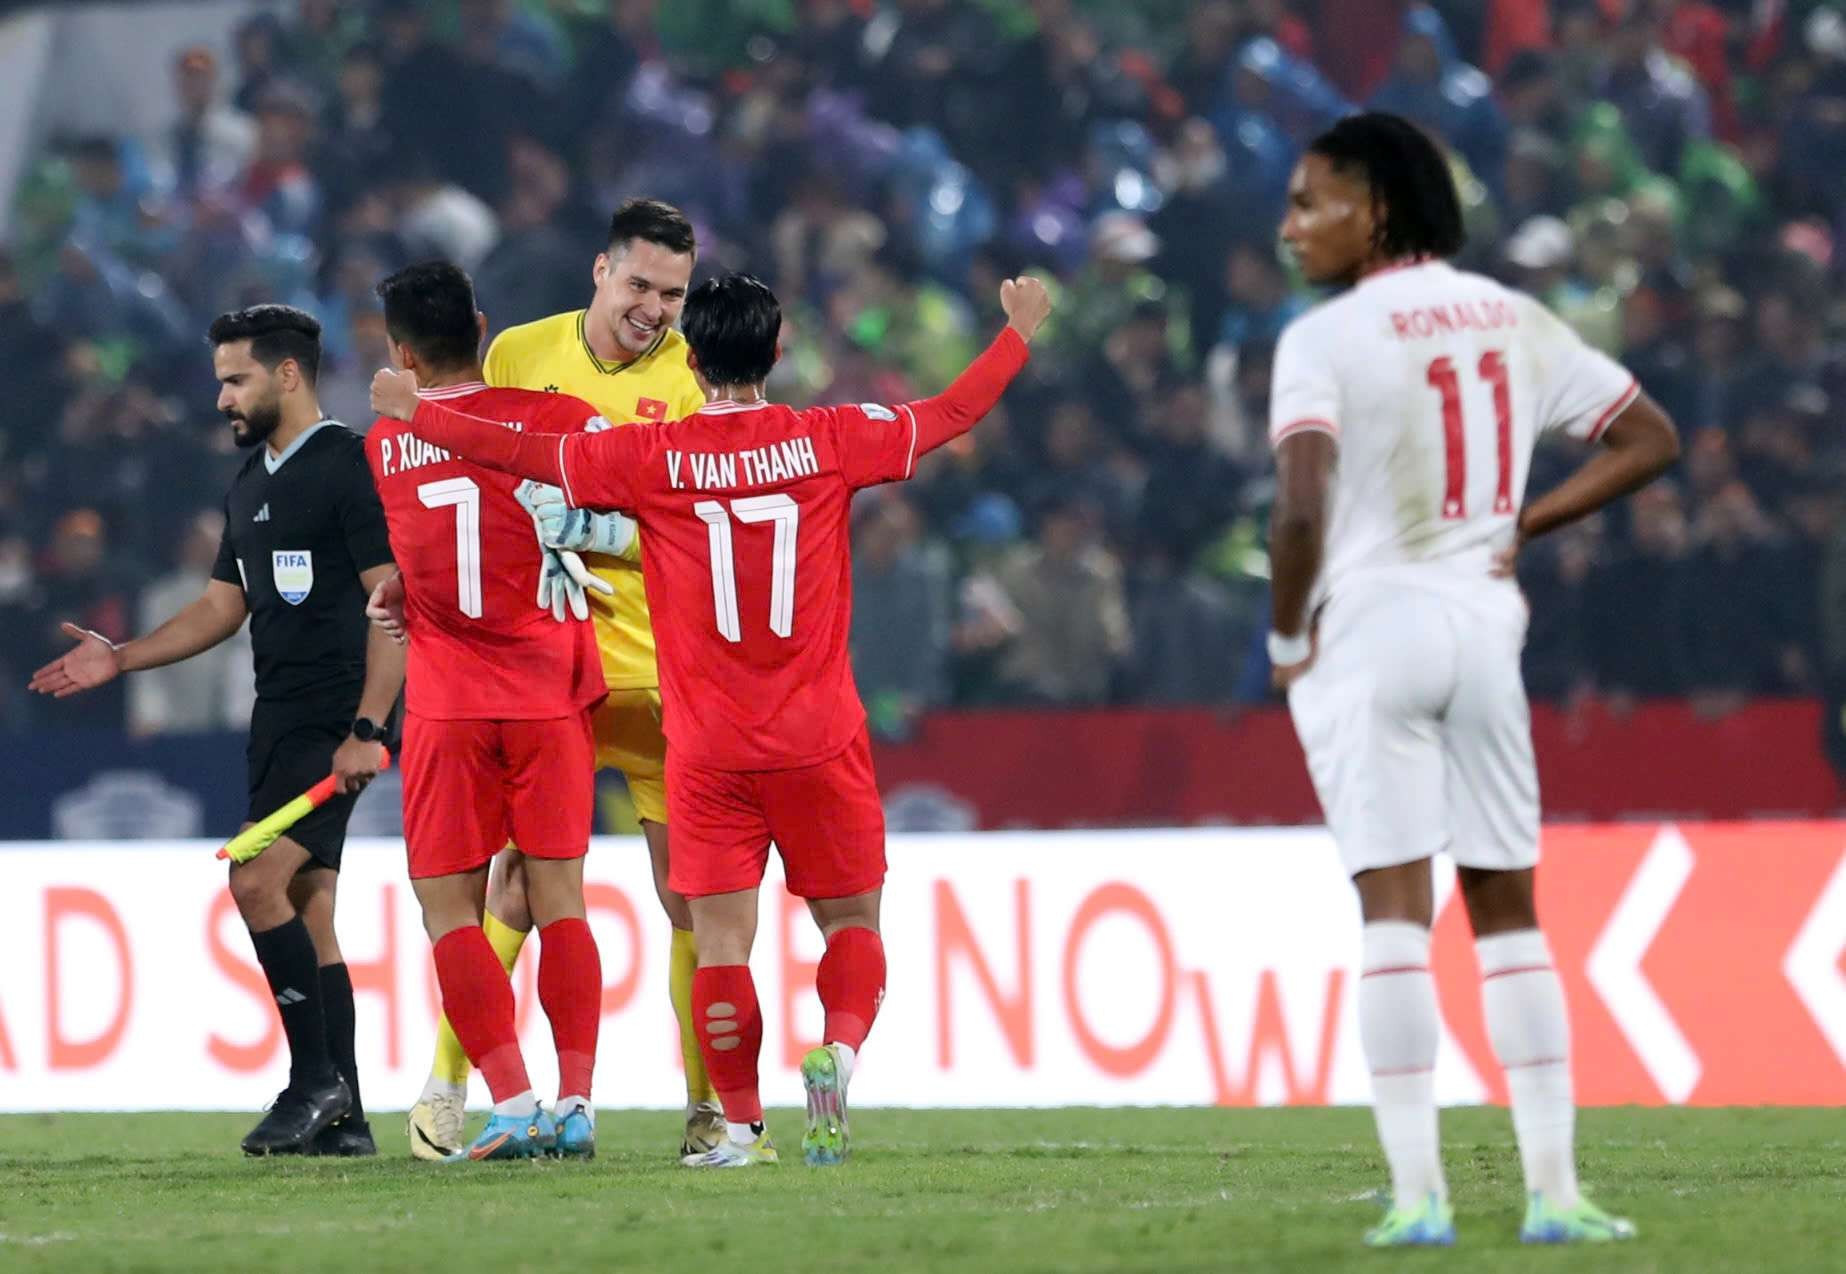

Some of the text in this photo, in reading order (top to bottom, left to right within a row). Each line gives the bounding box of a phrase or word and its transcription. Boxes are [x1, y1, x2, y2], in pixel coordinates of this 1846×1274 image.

[1390, 299, 1517, 340] RONALDO
[381, 437, 395, 477] P.
[667, 437, 819, 490] V. VAN THANH
[1426, 350, 1514, 519] 11
[276, 554, 307, 568] FIFA
[417, 476, 482, 619] 7
[694, 493, 799, 642] 17
[0, 877, 1346, 1105] D SHPE NOW
